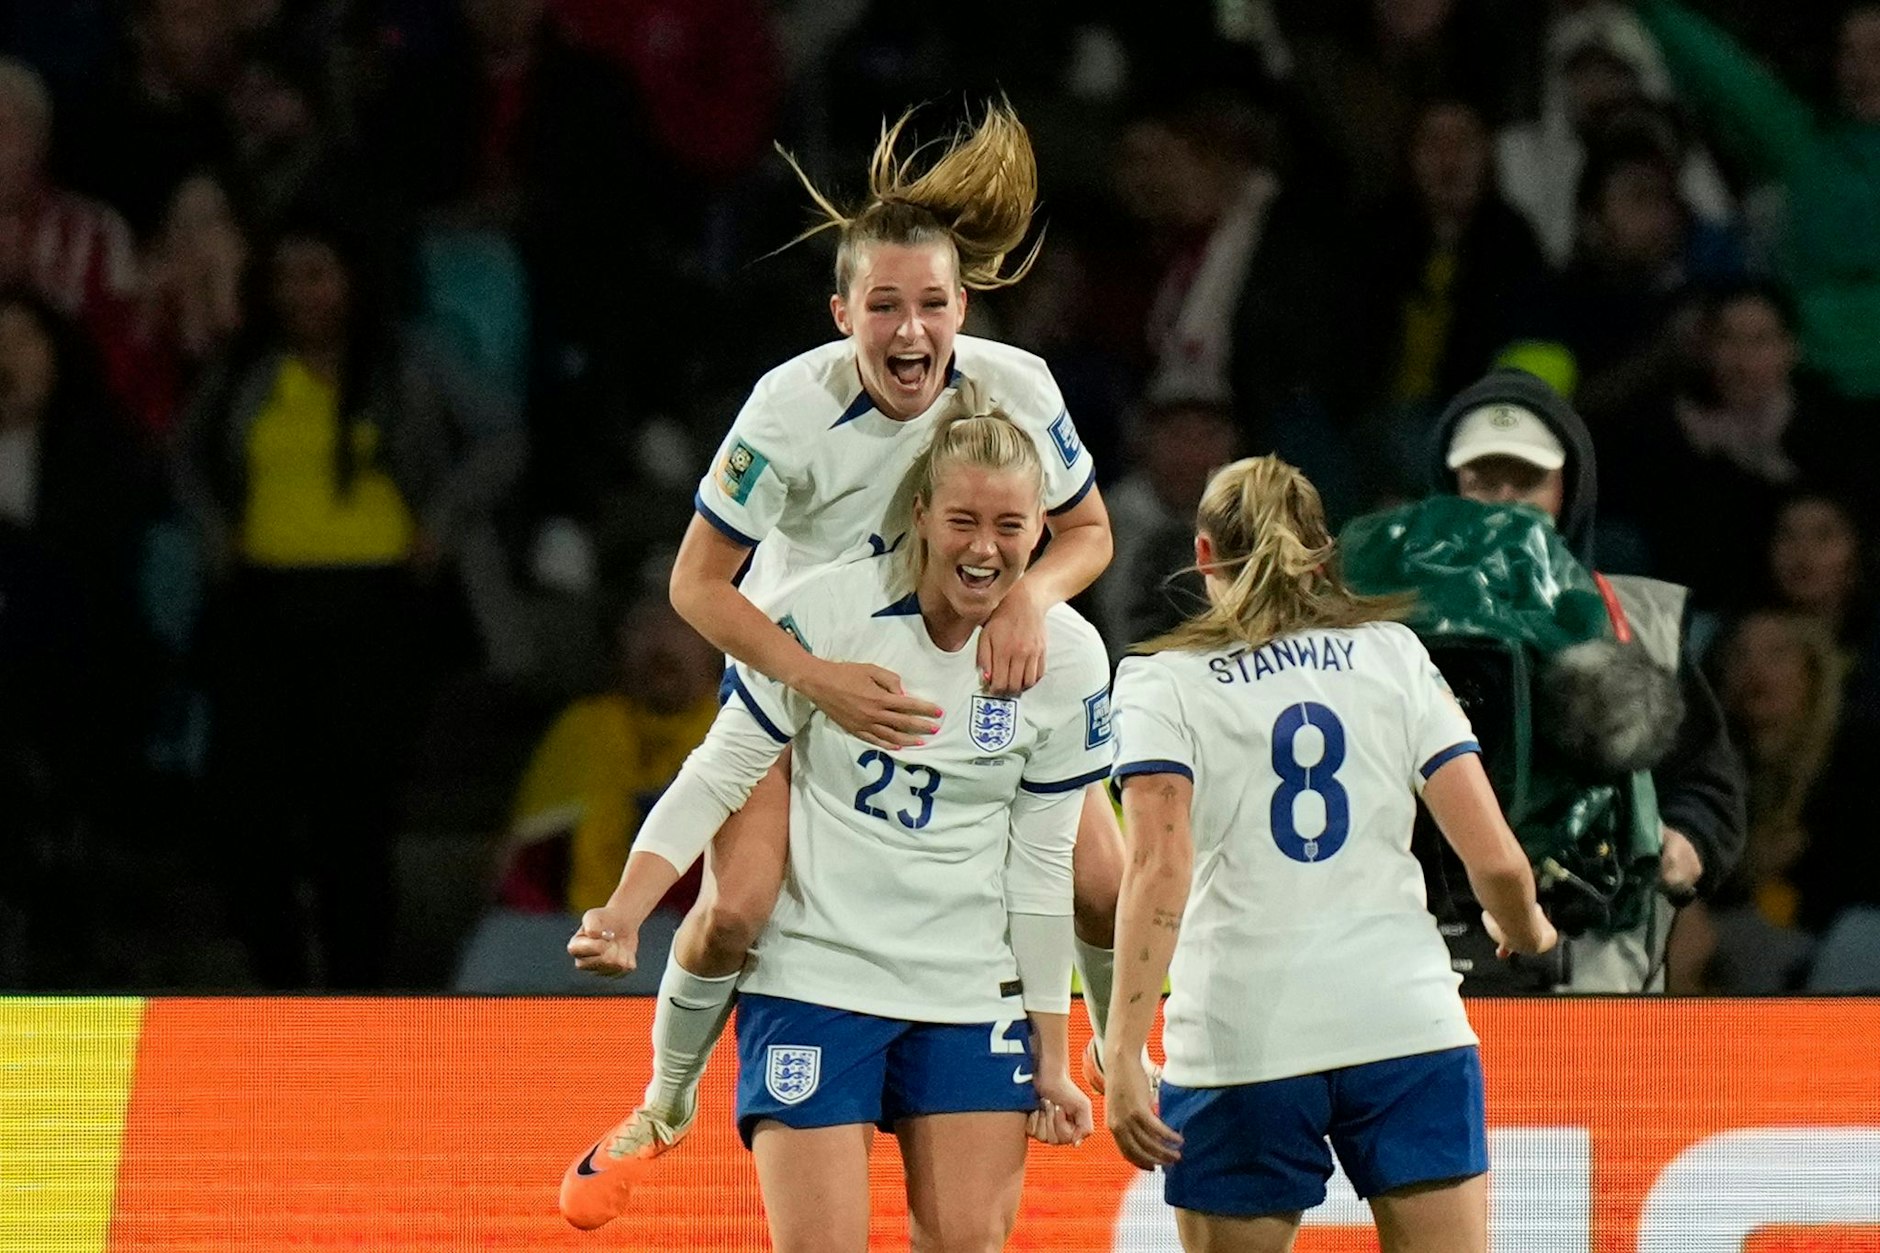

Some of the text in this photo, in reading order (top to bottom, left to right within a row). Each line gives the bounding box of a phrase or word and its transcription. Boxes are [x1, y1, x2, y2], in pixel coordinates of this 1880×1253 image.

[1209, 636, 1355, 684] STANWAY
[854, 749, 942, 830] 23
[1270, 701, 1350, 863] 8
